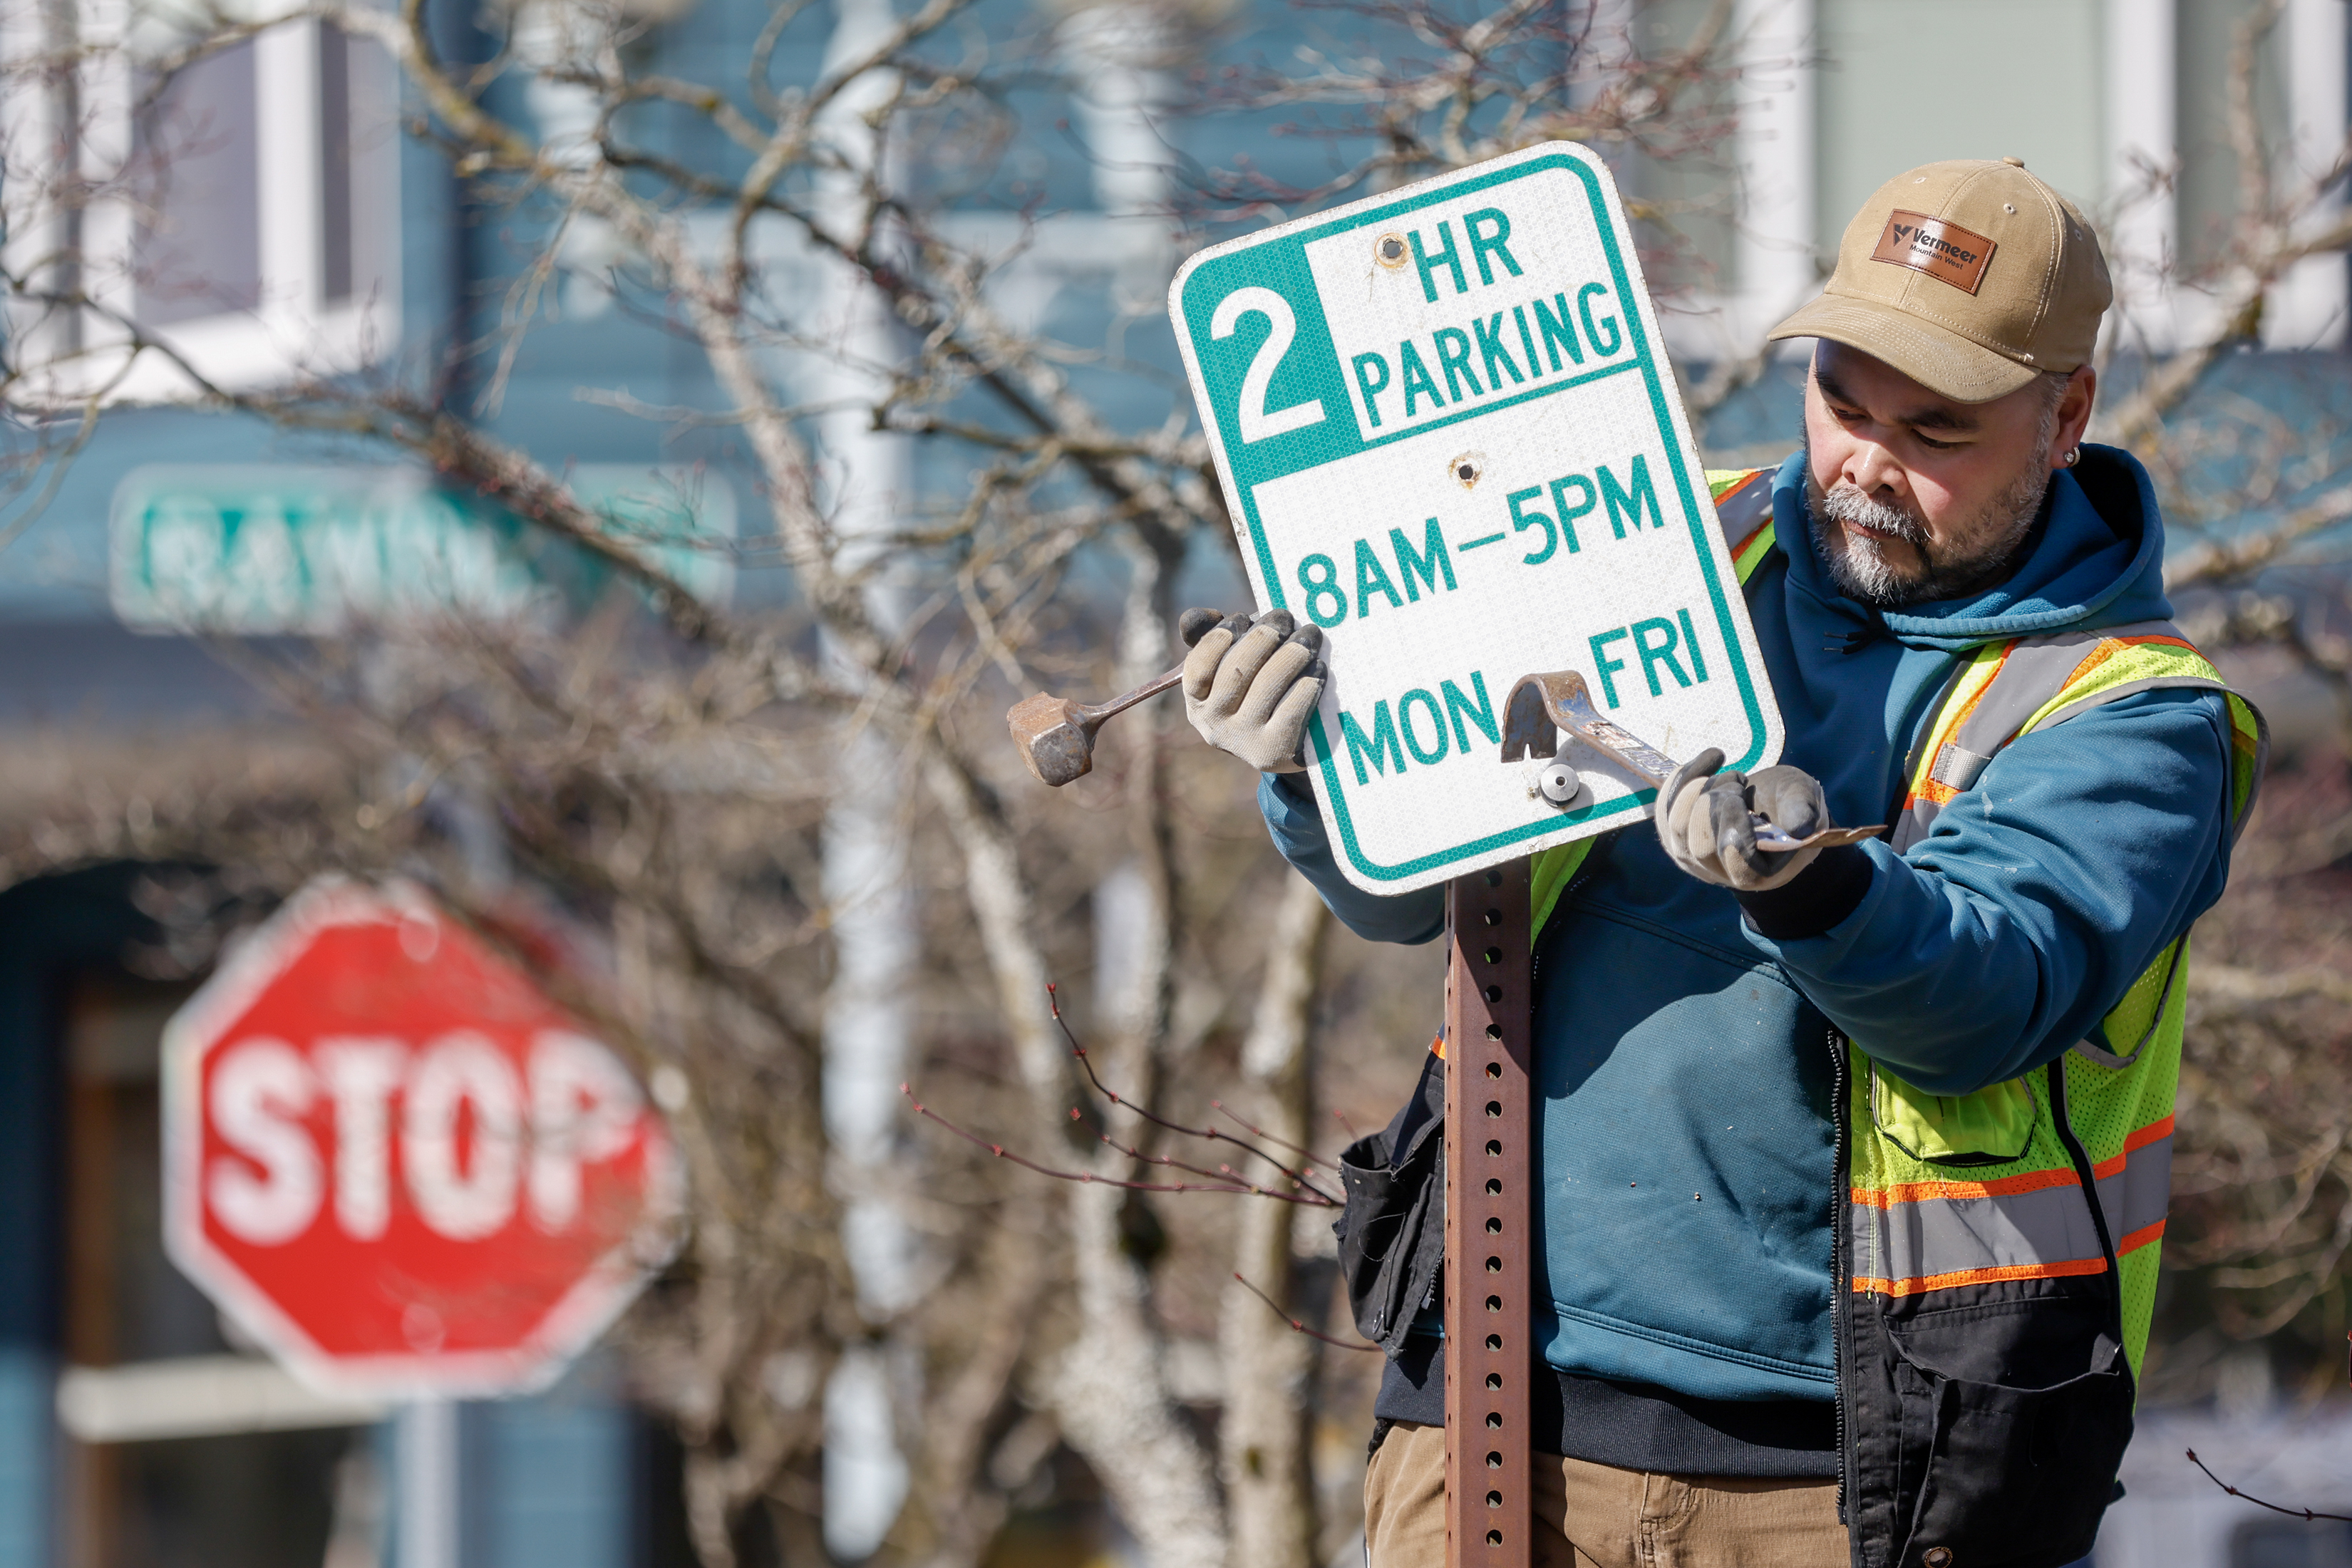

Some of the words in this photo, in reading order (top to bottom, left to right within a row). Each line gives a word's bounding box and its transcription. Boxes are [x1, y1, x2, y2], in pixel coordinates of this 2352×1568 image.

[1210, 287, 1326, 445] 2
[1408, 207, 1524, 303] HR
[1909, 244, 1943, 261] Mountain
[1944, 257, 1964, 270] West
[1913, 227, 1978, 264] Vermeer
[1352, 282, 1621, 427] PARKING
[1338, 671, 1502, 785] MON
[1588, 608, 1709, 710] FRI
[211, 1031, 641, 1244] STOP
